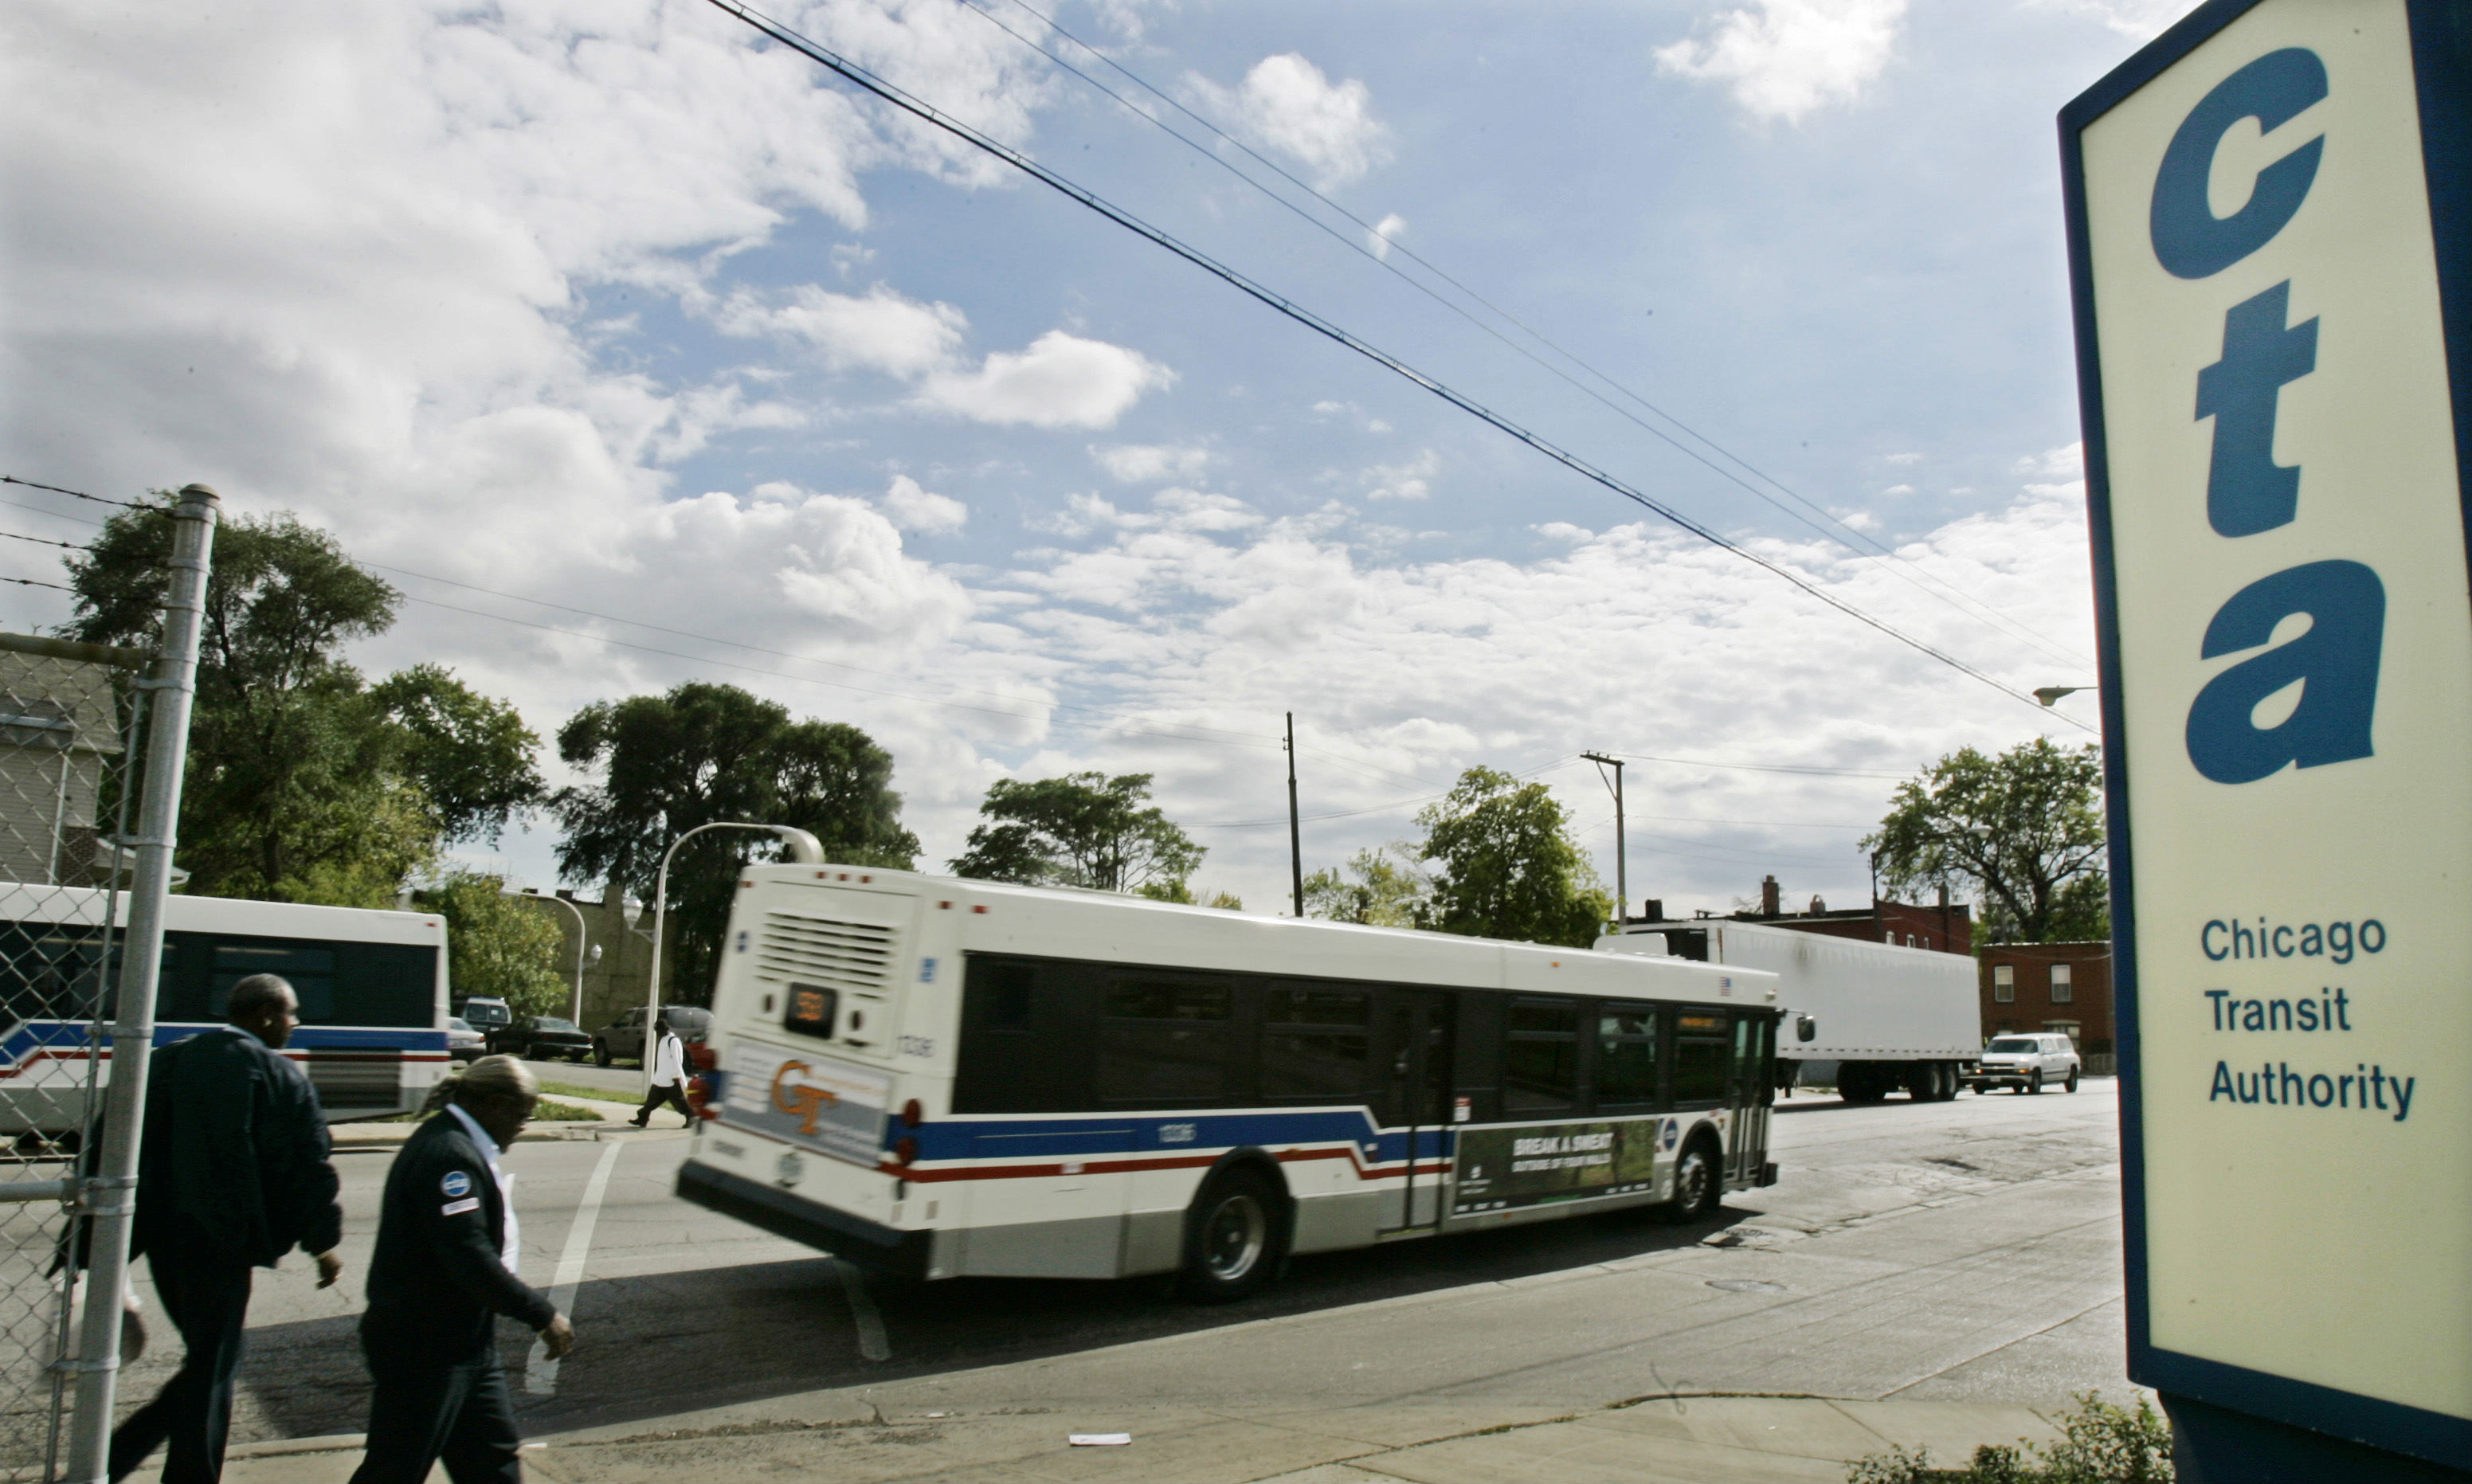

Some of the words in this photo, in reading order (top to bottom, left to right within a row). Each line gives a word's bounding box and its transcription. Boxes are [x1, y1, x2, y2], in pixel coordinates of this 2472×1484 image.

[2150, 47, 2386, 785] cta
[2201, 916, 2386, 965] Chicago
[2204, 987, 2352, 1032] Transit
[2209, 1060, 2415, 1122] Authority
[1513, 1137, 1561, 1156] BREAK
[1560, 1136, 1571, 1153] A
[1572, 1133, 1615, 1152] SWEAT
